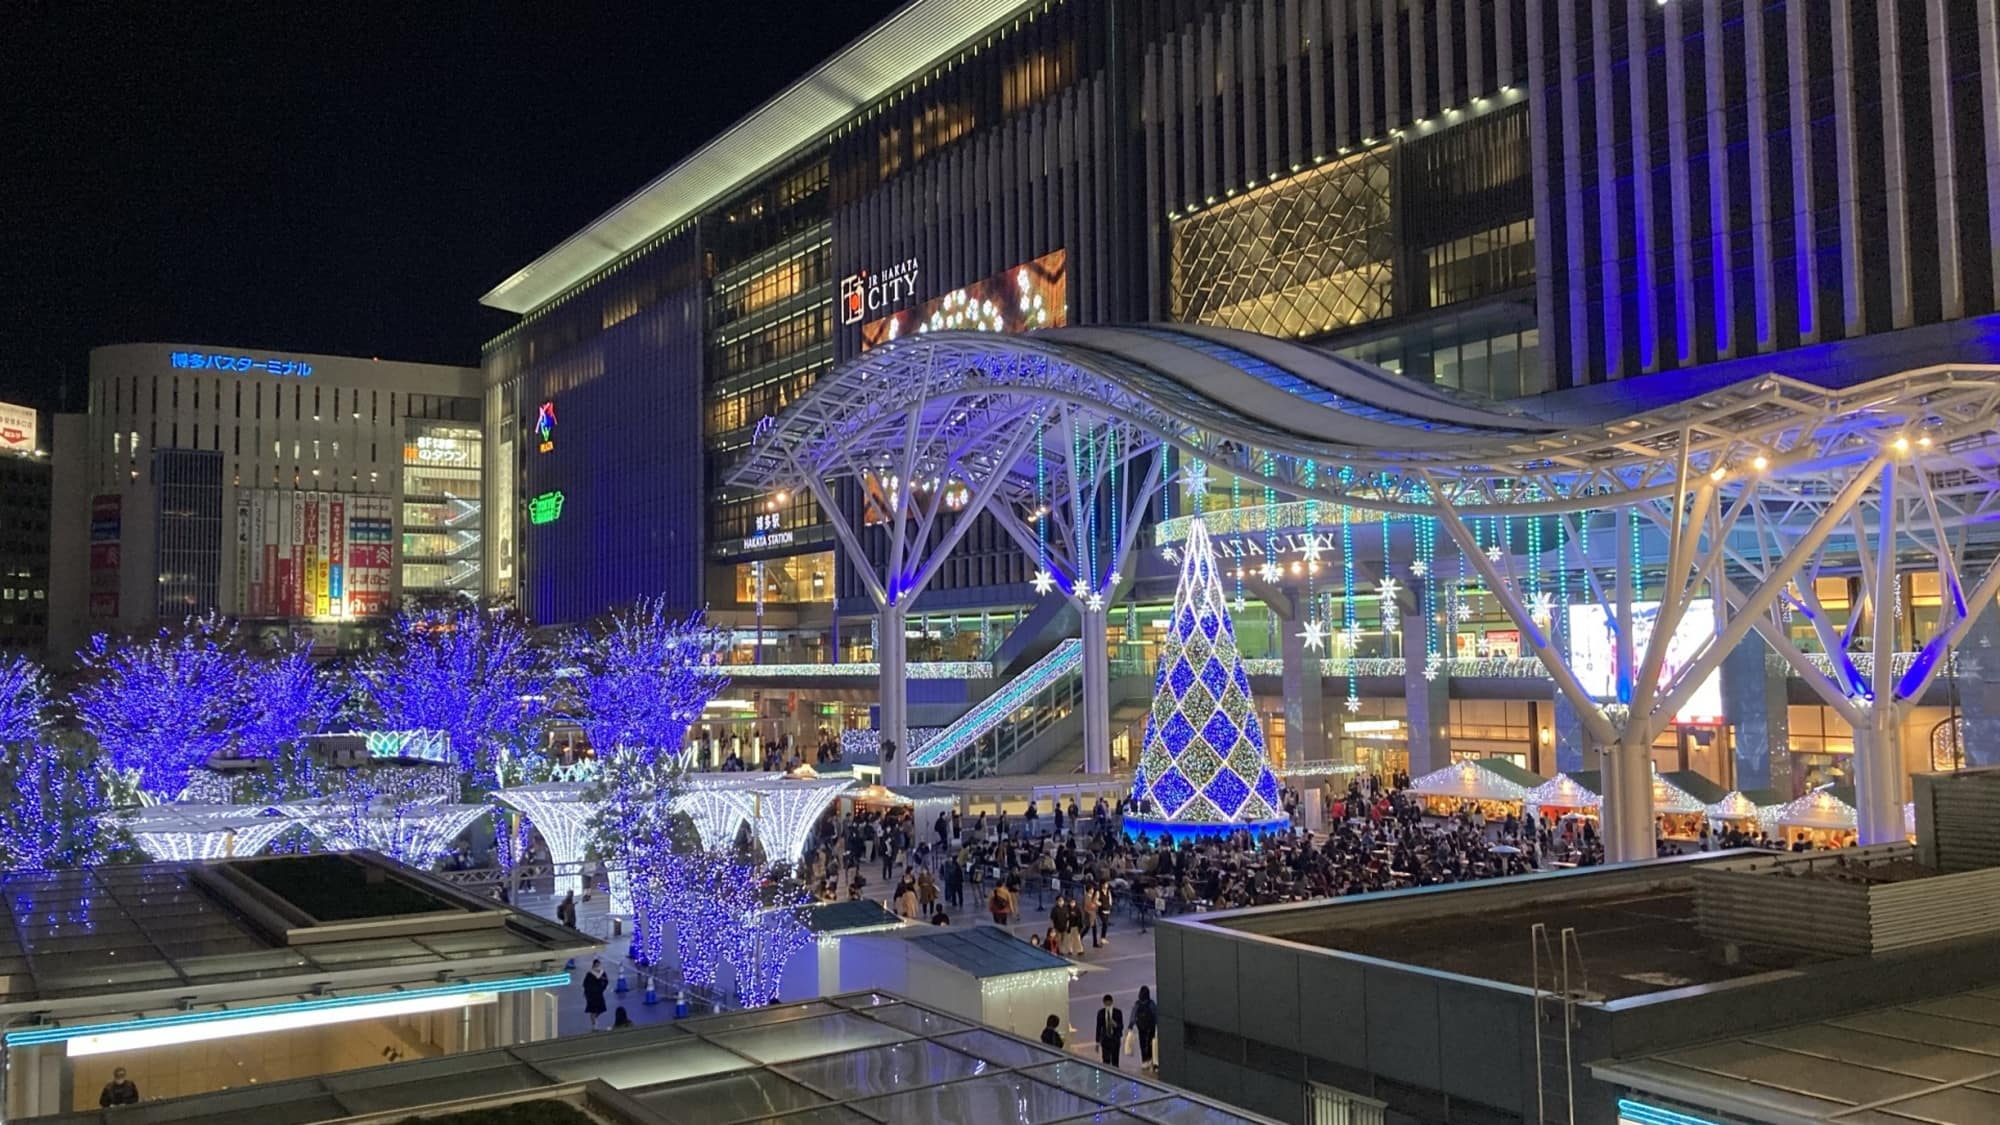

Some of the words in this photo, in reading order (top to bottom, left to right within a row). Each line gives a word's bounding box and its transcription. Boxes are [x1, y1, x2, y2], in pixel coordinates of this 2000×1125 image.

[868, 274, 878, 289] JR
[881, 257, 919, 282] HAKATA
[868, 269, 919, 311] CITY
[171, 352, 312, 376] 博多バスターミナル
[744, 534, 767, 550] HAKATA
[768, 531, 793, 546] STATION
